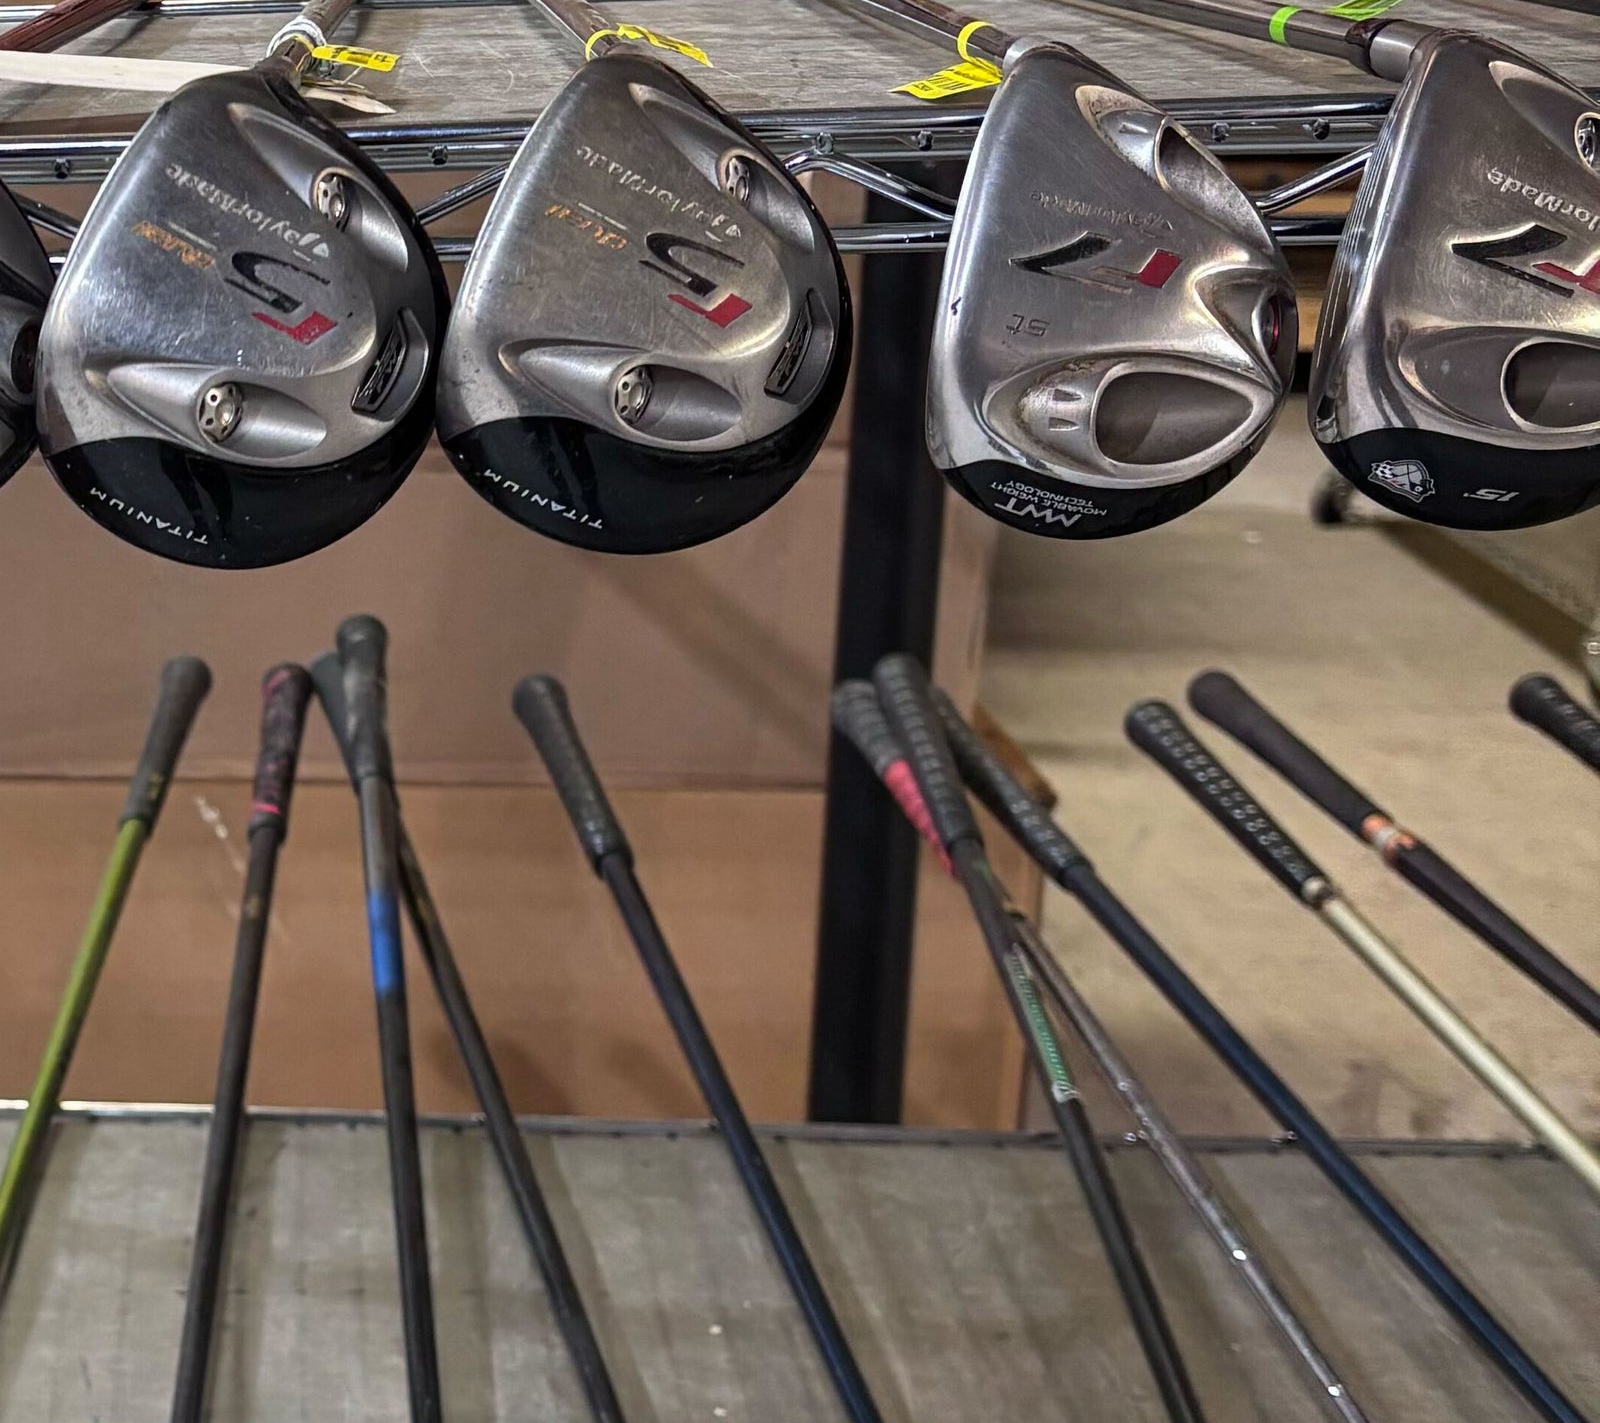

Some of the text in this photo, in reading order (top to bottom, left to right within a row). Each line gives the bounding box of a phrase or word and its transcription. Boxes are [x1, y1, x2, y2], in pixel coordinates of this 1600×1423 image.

[162, 160, 328, 262] TaylorMade
[572, 141, 741, 244] TaylorMade
[1486, 167, 1600, 230] lorMade
[87, 485, 208, 544] TITANIUM
[480, 466, 603, 529] TITANIUM
[989, 481, 1107, 515] MOVABLE WEIGHT
[993, 496, 1082, 527] MWT
[1005, 479, 1093, 507] TECHNOLOGY
